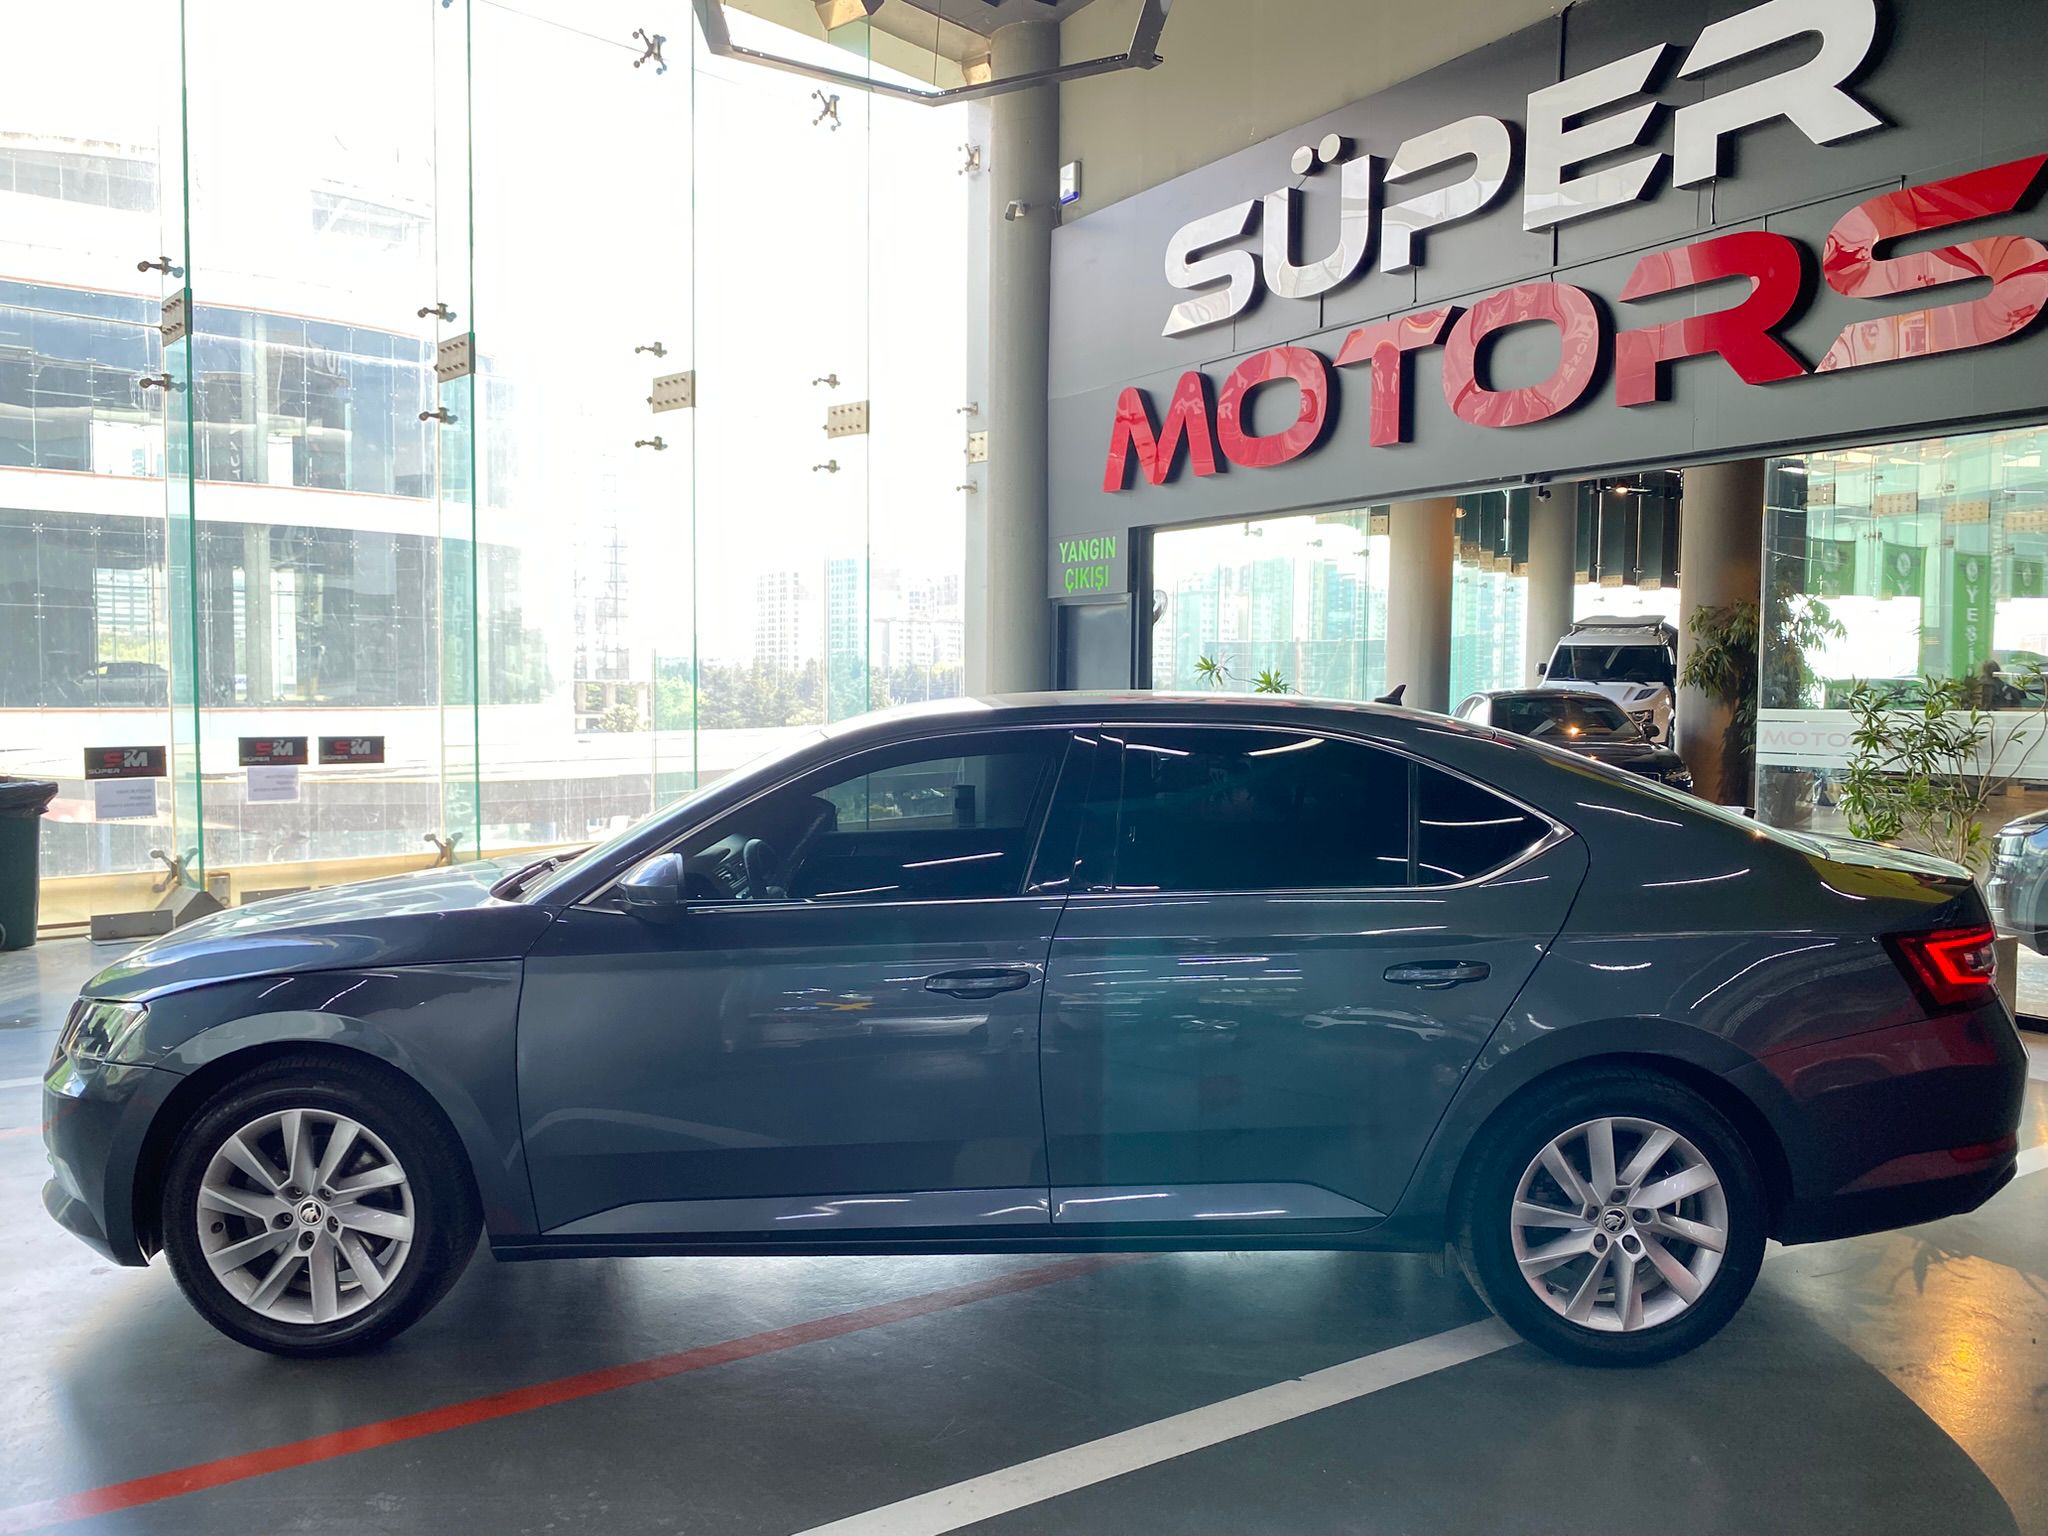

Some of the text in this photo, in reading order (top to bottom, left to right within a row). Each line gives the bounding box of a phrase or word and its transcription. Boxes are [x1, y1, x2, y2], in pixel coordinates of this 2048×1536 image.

[1161, 0, 1884, 337] SÜPER
[1103, 153, 2048, 493] MOTORS
[1059, 536, 1116, 563] YANGIN
[1064, 565, 1109, 593] ÇIKIŞI
[1762, 729, 1853, 748] MOTO
